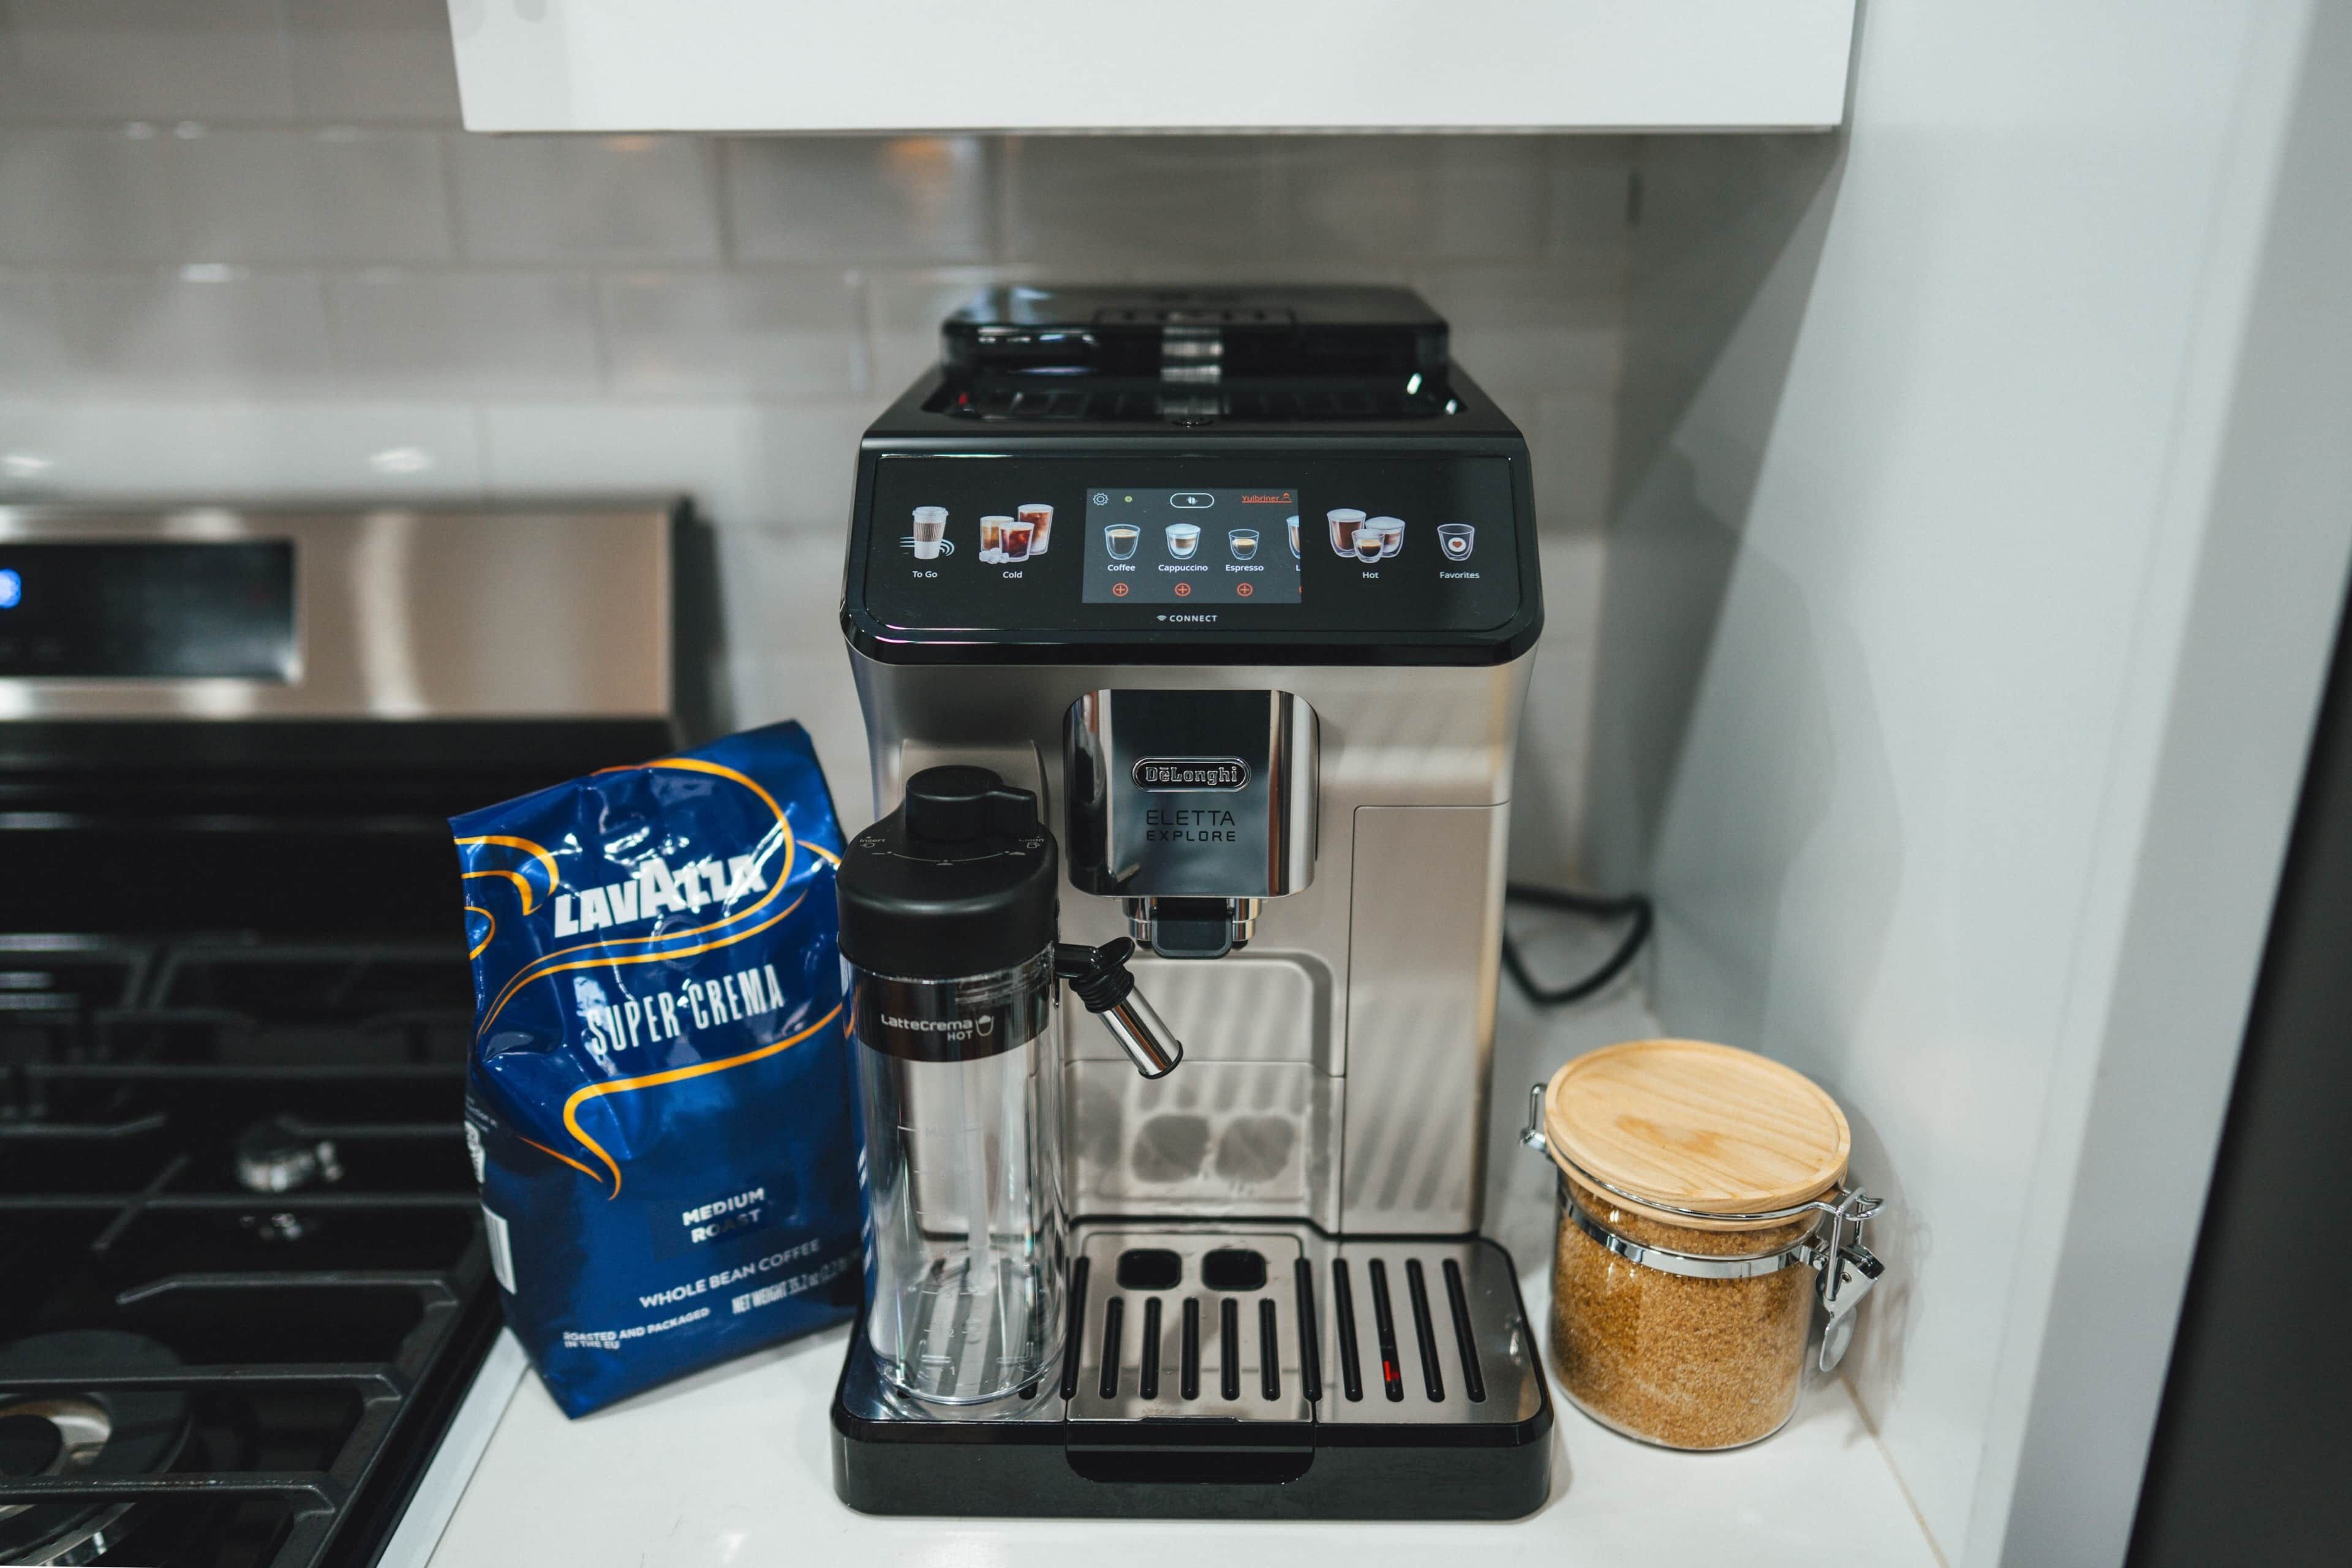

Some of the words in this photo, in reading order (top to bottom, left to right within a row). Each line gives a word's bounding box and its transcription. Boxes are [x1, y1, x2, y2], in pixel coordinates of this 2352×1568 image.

[1002, 570, 1023, 579] Cold
[1158, 564, 1208, 573] Cappuccino
[1225, 564, 1264, 573] Espresso
[1439, 571, 1480, 579] Favorites
[1146, 810, 1235, 826] ELETTA
[1146, 831, 1235, 842] EXPLORE
[554, 854, 767, 938] LAVAZZA
[586, 991, 680, 1057] SUPER
[687, 963, 786, 1030] CREMA
[881, 1014, 973, 1031] LatteCrema
[947, 1030, 973, 1041] HOT
[682, 1187, 765, 1226] MEDIUM
[690, 1208, 761, 1243] ROAST
[639, 1278, 707, 1308] WHOLE
[709, 1262, 756, 1289] BEAN
[758, 1237, 821, 1272] COFFEE
[563, 1330, 617, 1341] ROASTED
[618, 1325, 646, 1340] AND
[646, 1306, 712, 1335] PACKAGED
[564, 1340, 578, 1349] IN
[579, 1340, 602, 1349] THE
[603, 1340, 621, 1351] EU
